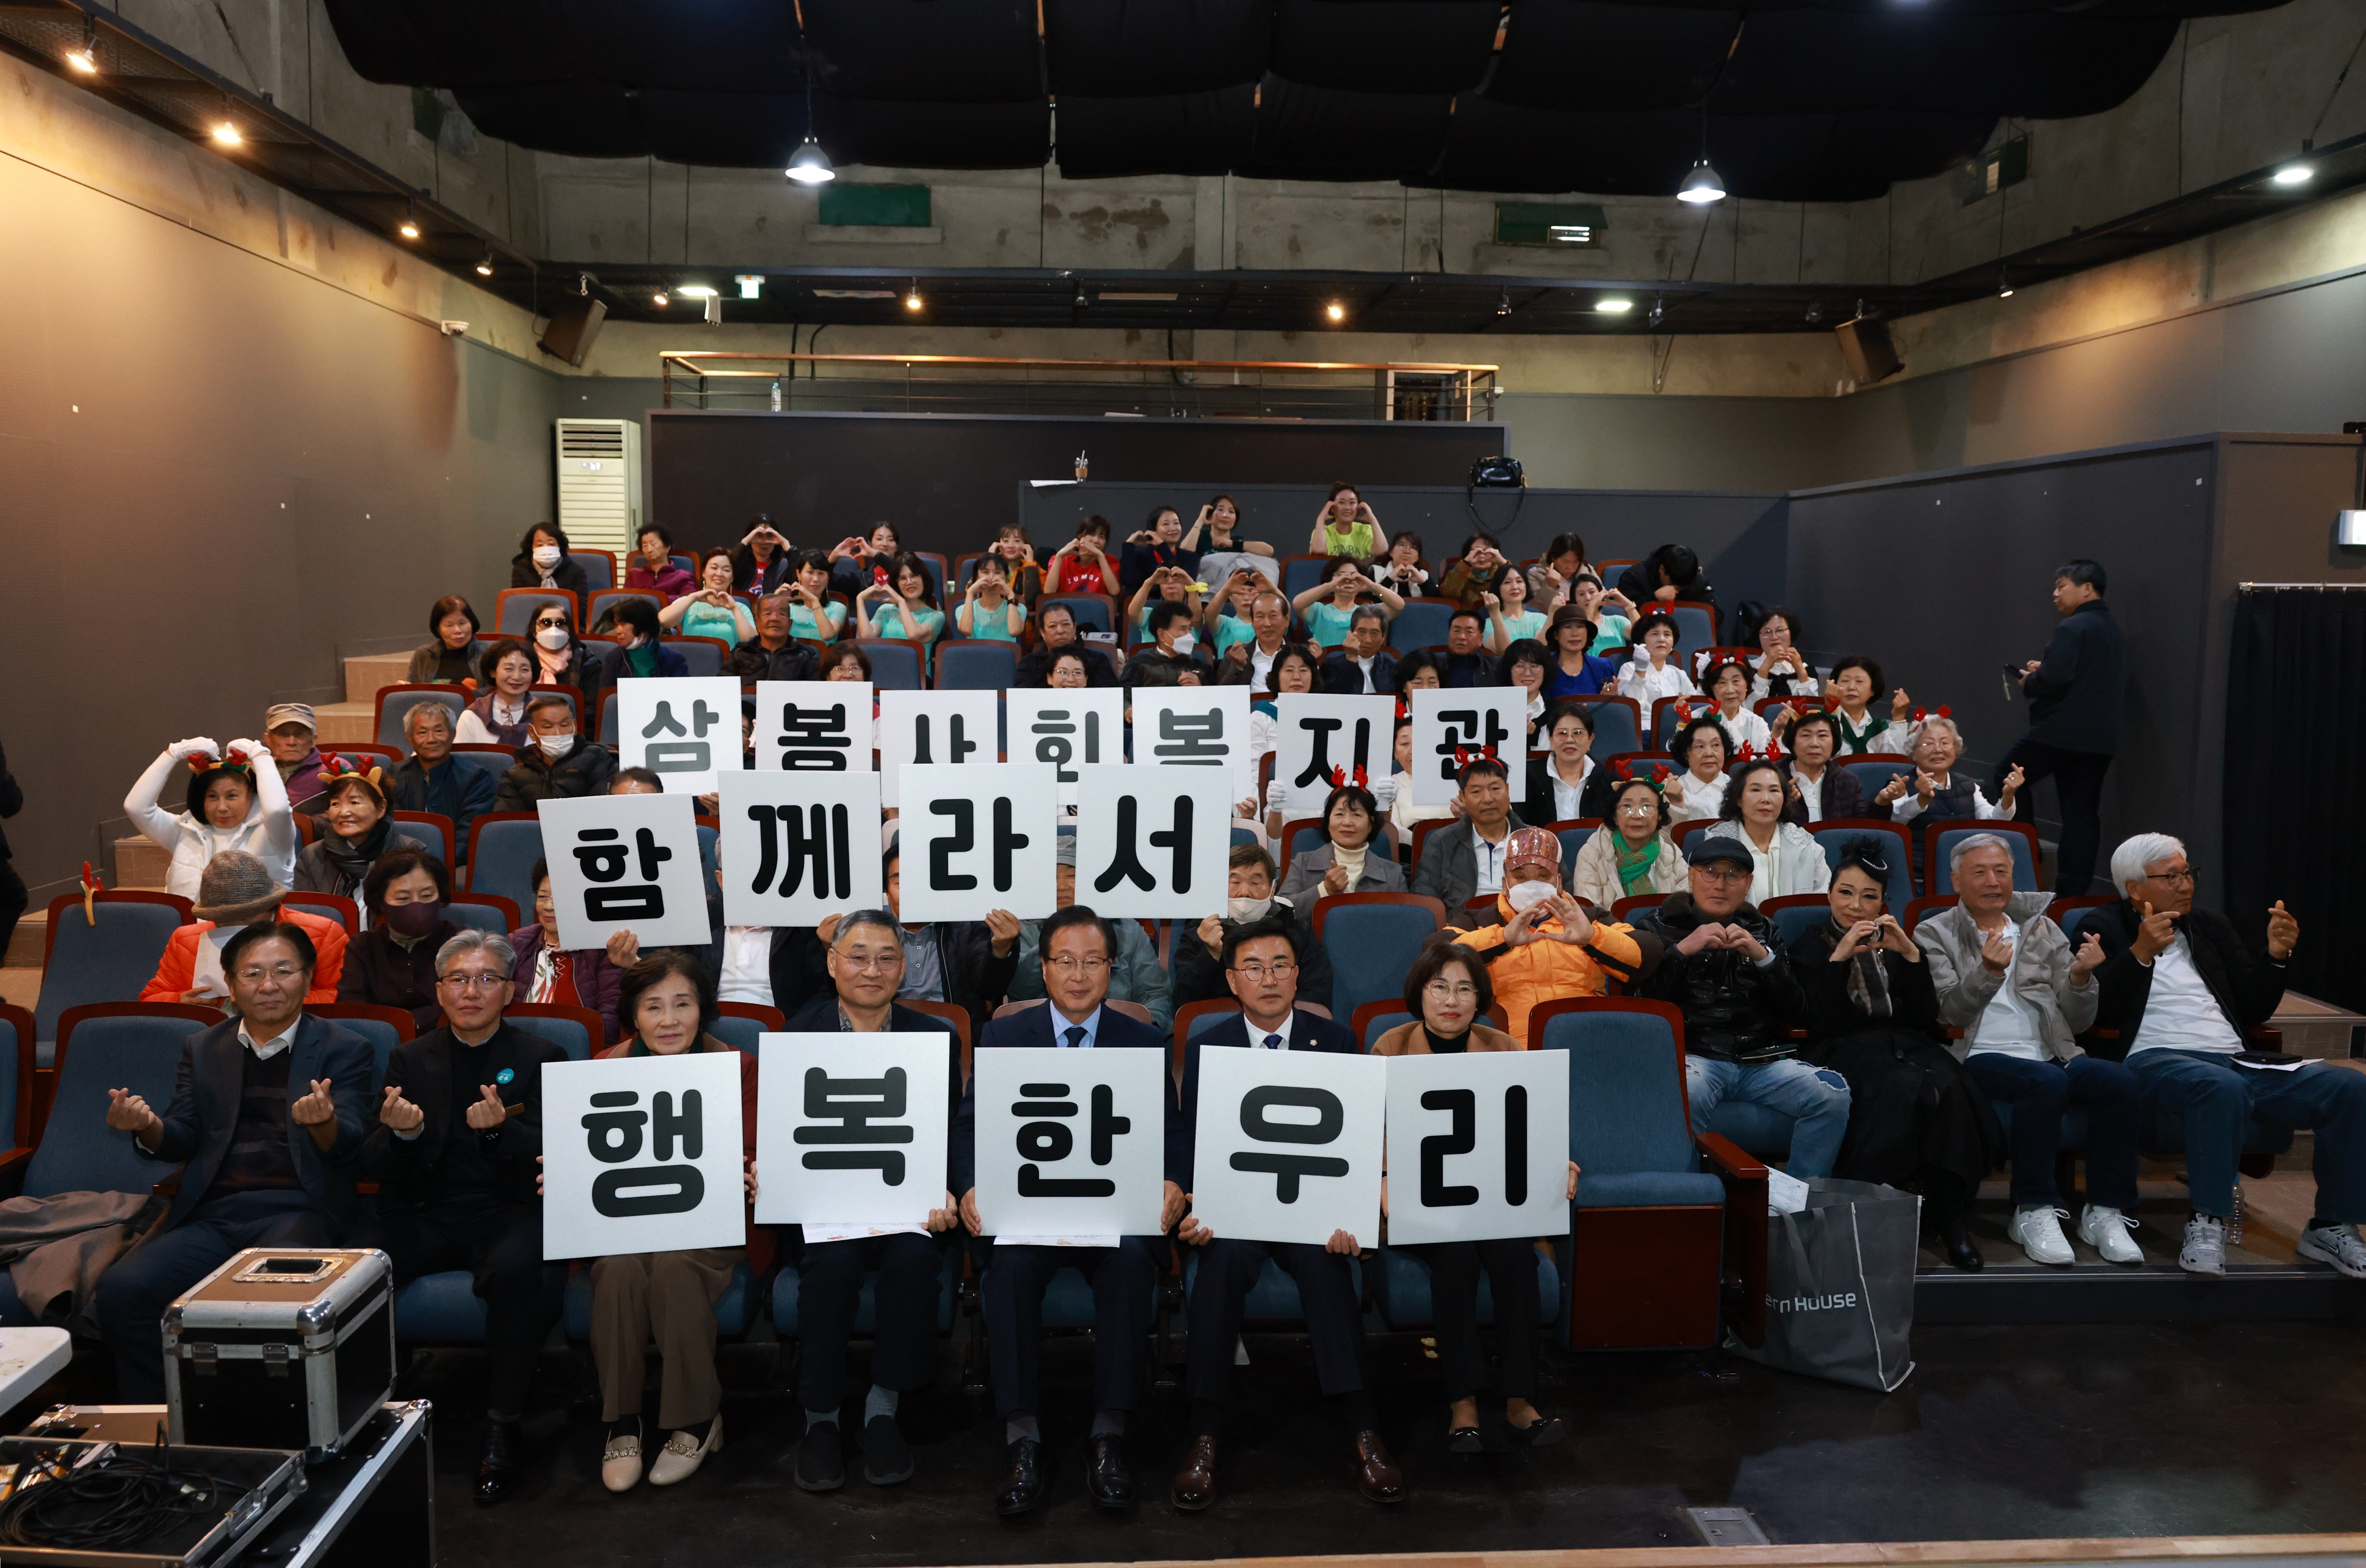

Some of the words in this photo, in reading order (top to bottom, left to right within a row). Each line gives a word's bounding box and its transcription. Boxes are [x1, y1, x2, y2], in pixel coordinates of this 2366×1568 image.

[1067, 574, 1099, 584] ZUMBA
[573, 795, 1193, 921] 함께라서
[581, 1067, 1131, 1217] 행복한
[1230, 1085, 1527, 1207] 우리
